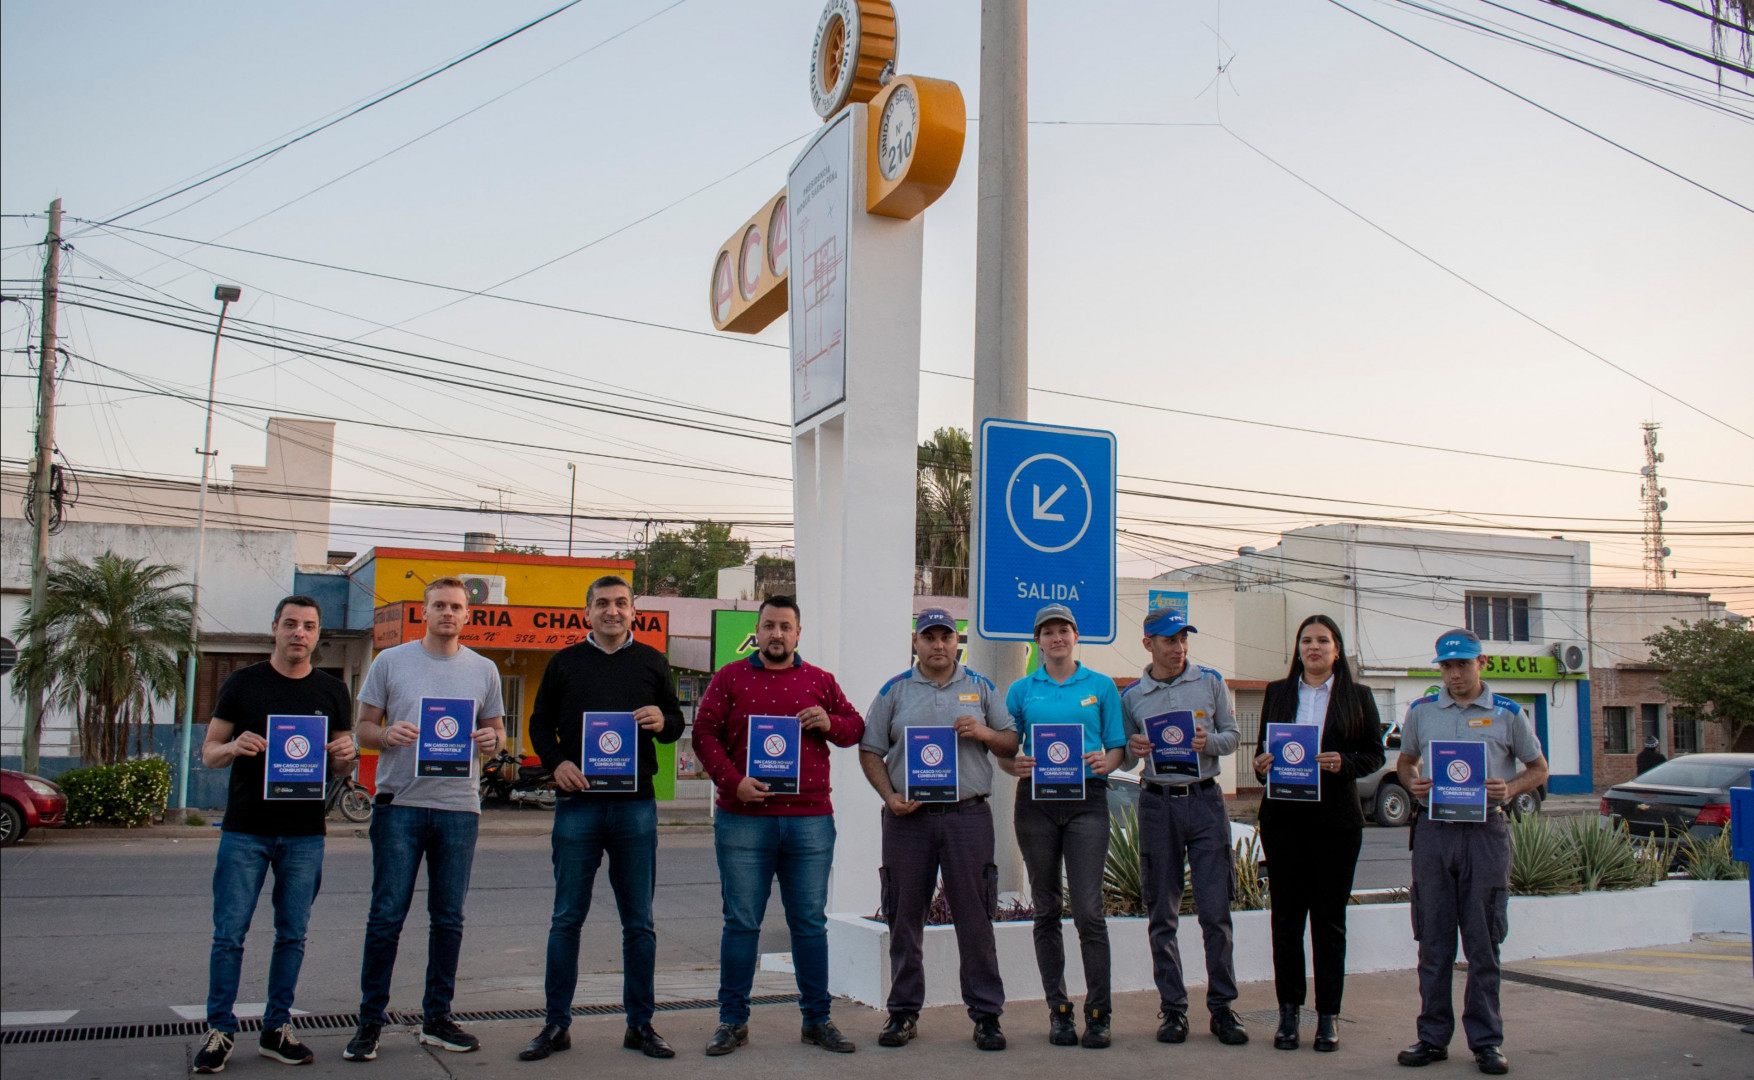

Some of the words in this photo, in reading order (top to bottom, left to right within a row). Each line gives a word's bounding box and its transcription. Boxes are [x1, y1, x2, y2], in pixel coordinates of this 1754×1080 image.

[810, 25, 824, 108] AUTOMOVIL
[882, 103, 894, 158] UNIDAD
[896, 90, 916, 131] SERVICIAL
[888, 130, 912, 174] 210
[803, 165, 830, 197] PRESIDENCIA
[716, 200, 788, 315] ACA
[1018, 582, 1080, 601] SALIDA
[408, 608, 512, 628] LRIA
[514, 634, 536, 643] 382
[545, 636, 558, 644] 10
